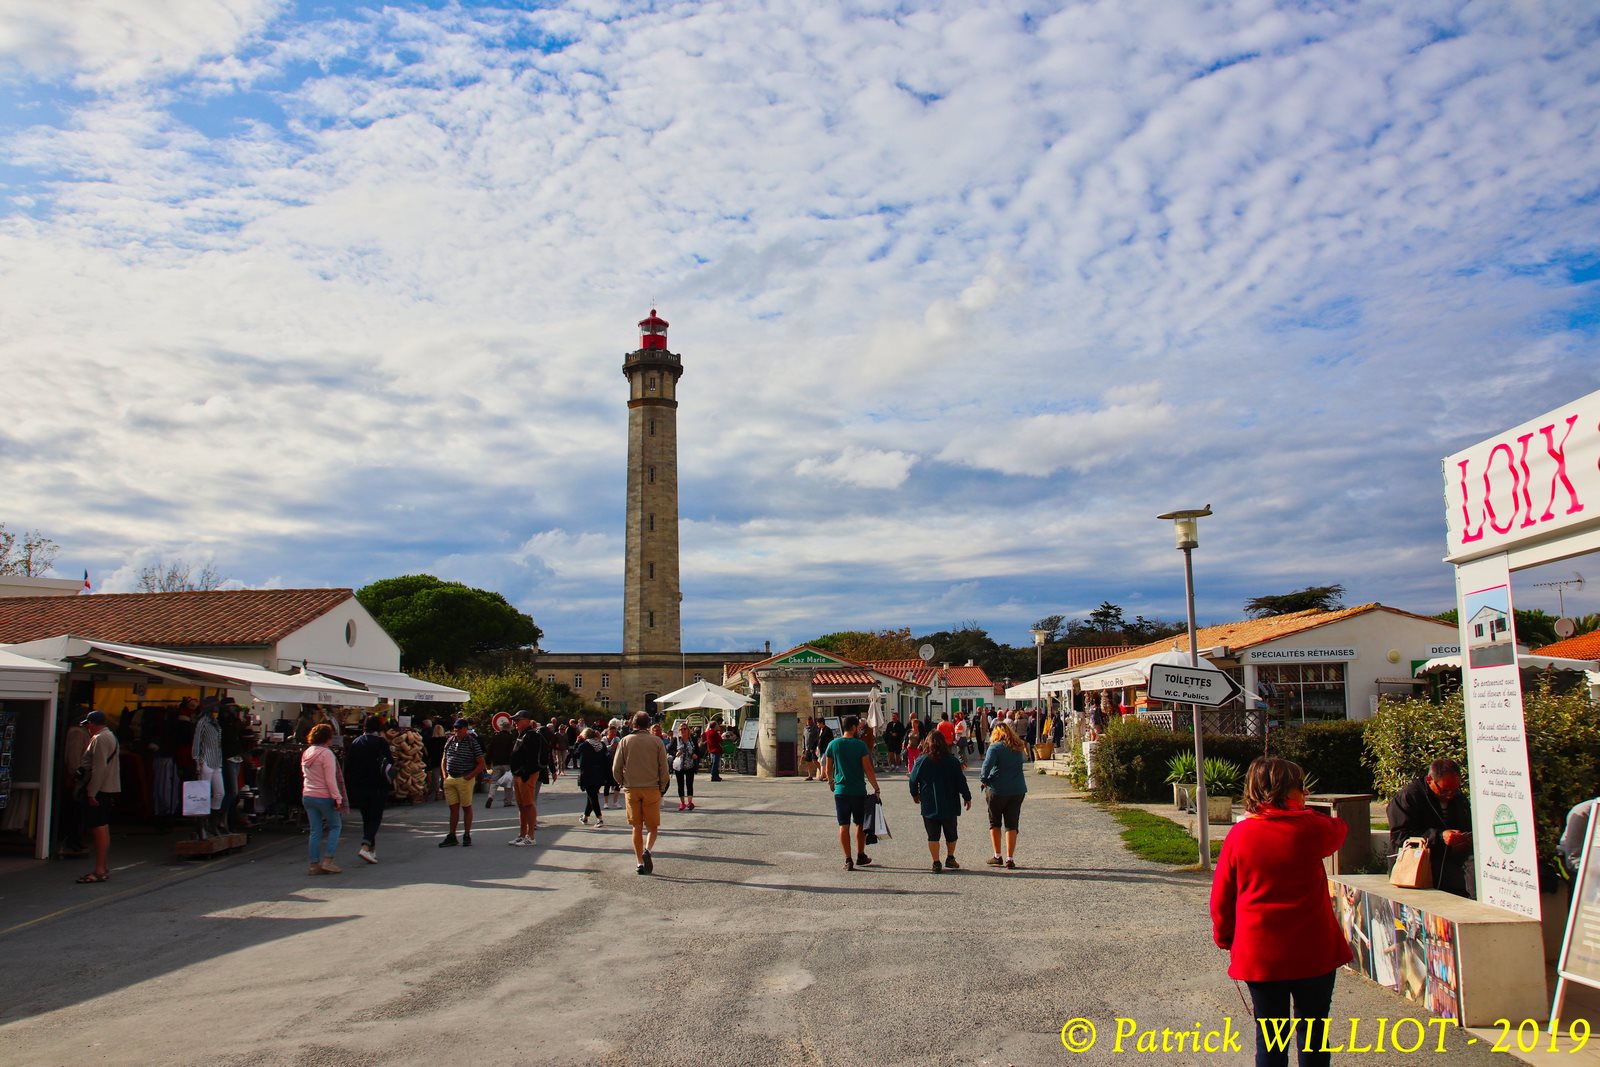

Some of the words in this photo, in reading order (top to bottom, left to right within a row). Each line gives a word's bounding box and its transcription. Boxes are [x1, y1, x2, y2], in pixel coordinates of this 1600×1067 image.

[1458, 414, 1584, 544] LOIX
[1250, 649, 1305, 658] SPÉCIALITÉS
[1307, 649, 1355, 657] RÉTHAISES
[1182, 692, 1209, 700] Publics
